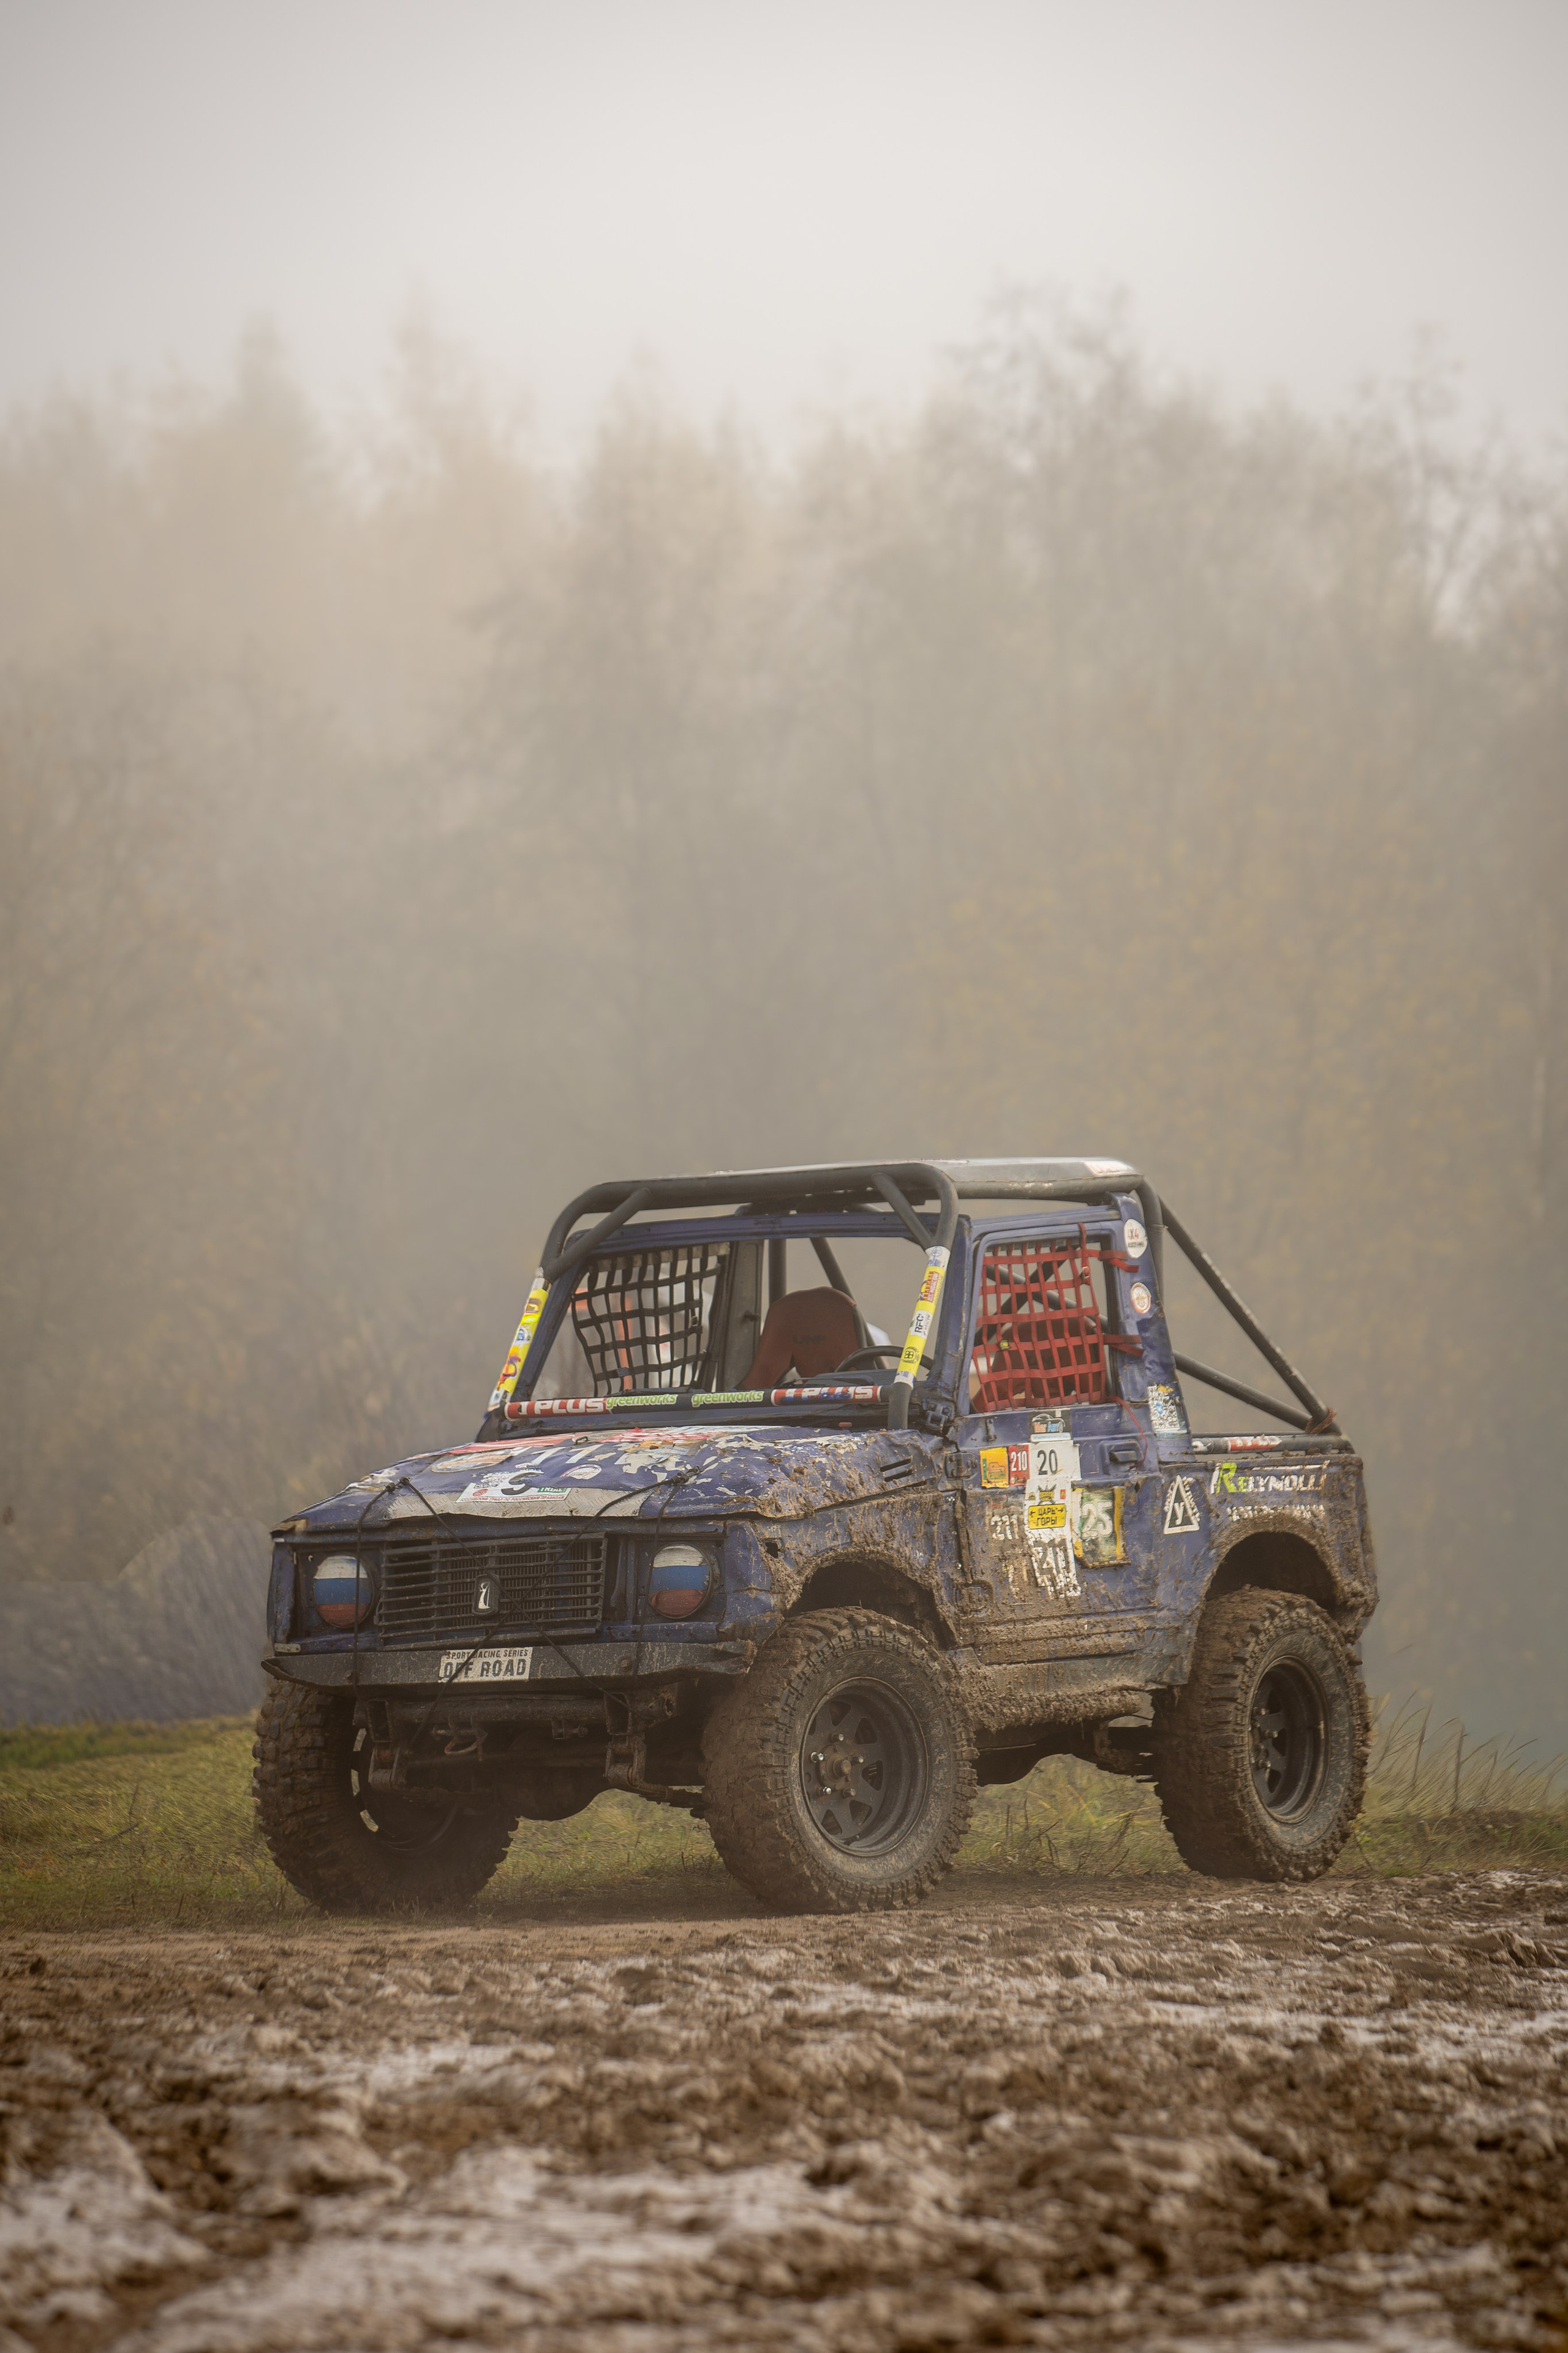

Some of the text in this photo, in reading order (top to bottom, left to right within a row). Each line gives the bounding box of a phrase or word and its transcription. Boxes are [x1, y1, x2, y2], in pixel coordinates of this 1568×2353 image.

[606, 1394, 679, 1410] greenworks
[692, 1390, 764, 1407] greenworks
[1011, 1450, 1028, 1471] 210
[1037, 1449, 1058, 1475] 20
[1082, 1500, 1114, 1539] 25
[446, 1651, 470, 1660] SPORT
[503, 1649, 529, 1658] SERIES
[480, 1658, 527, 1677] ROAD
